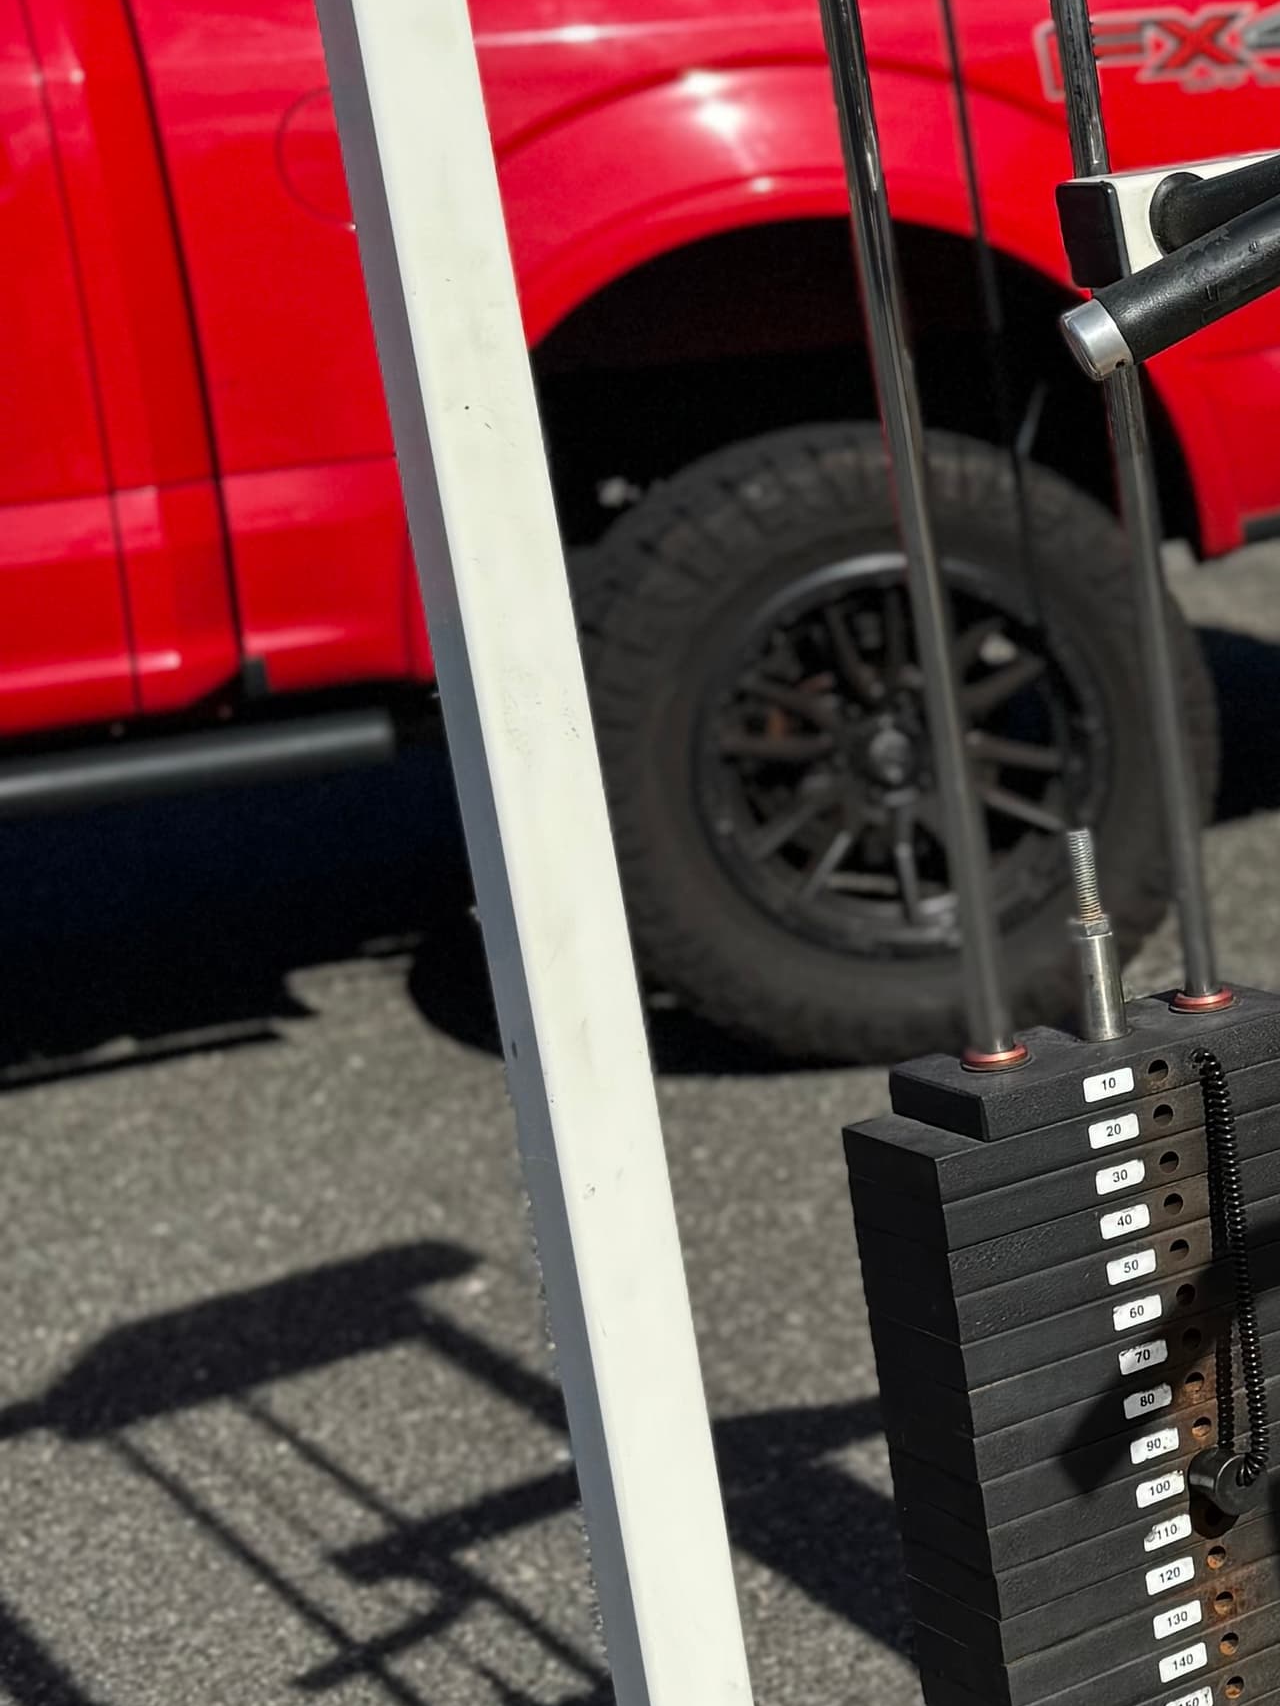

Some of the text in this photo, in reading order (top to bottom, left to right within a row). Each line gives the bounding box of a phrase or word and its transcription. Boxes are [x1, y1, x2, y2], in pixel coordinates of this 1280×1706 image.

[1102, 1077, 1116, 1090] 10
[1106, 1123, 1122, 1137] 20
[1112, 1169, 1128, 1183] 30
[1117, 1214, 1132, 1227] 40
[1124, 1259, 1139, 1274] 50
[1129, 1305, 1144, 1319] 60
[1135, 1348, 1150, 1364] 70
[1140, 1392, 1155, 1407] 80
[1146, 1438, 1161, 1452] 90
[1150, 1480, 1171, 1496] 100
[1157, 1524, 1178, 1540] 110
[1159, 1567, 1180, 1583] 120
[1167, 1611, 1188, 1627] 130
[1173, 1654, 1194, 1670] 140
